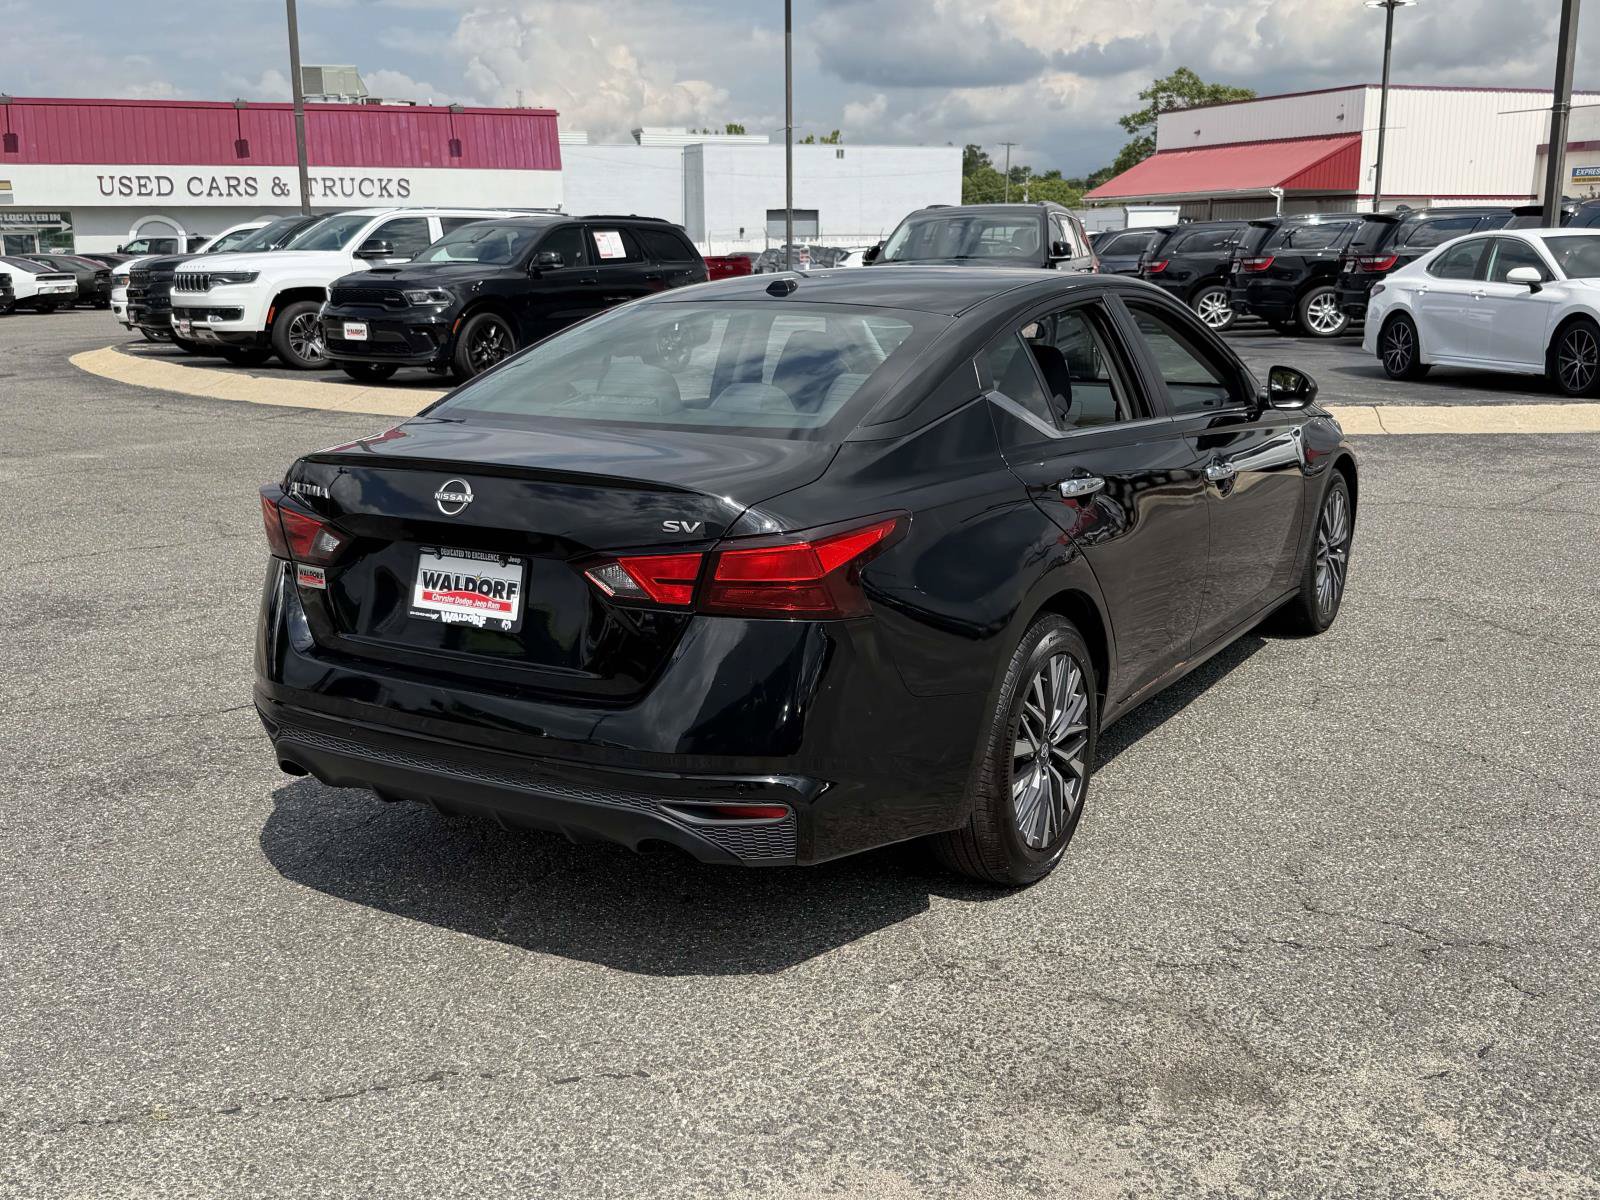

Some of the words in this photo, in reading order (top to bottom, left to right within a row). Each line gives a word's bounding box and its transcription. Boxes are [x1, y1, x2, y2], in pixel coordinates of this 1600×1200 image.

[97, 175, 174, 197] USED
[187, 175, 258, 198] CARS
[271, 176, 290, 197] &
[307, 176, 410, 198] TRUCKS
[5, 213, 48, 222] LOCATED
[50, 213, 61, 221] IN
[434, 492, 474, 503] NISSAN
[662, 520, 701, 534] SV
[440, 548, 465, 558] DEDICATED
[472, 551, 500, 561] EXCELLENCE
[508, 556, 521, 564] Jeep
[422, 570, 519, 601] WALDORF
[432, 593, 455, 604] Chrysler
[456, 596, 473, 606] Dodge
[473, 599, 488, 608] Jeep
[488, 600, 500, 609] Ram
[441, 611, 486, 628] WALDORF
